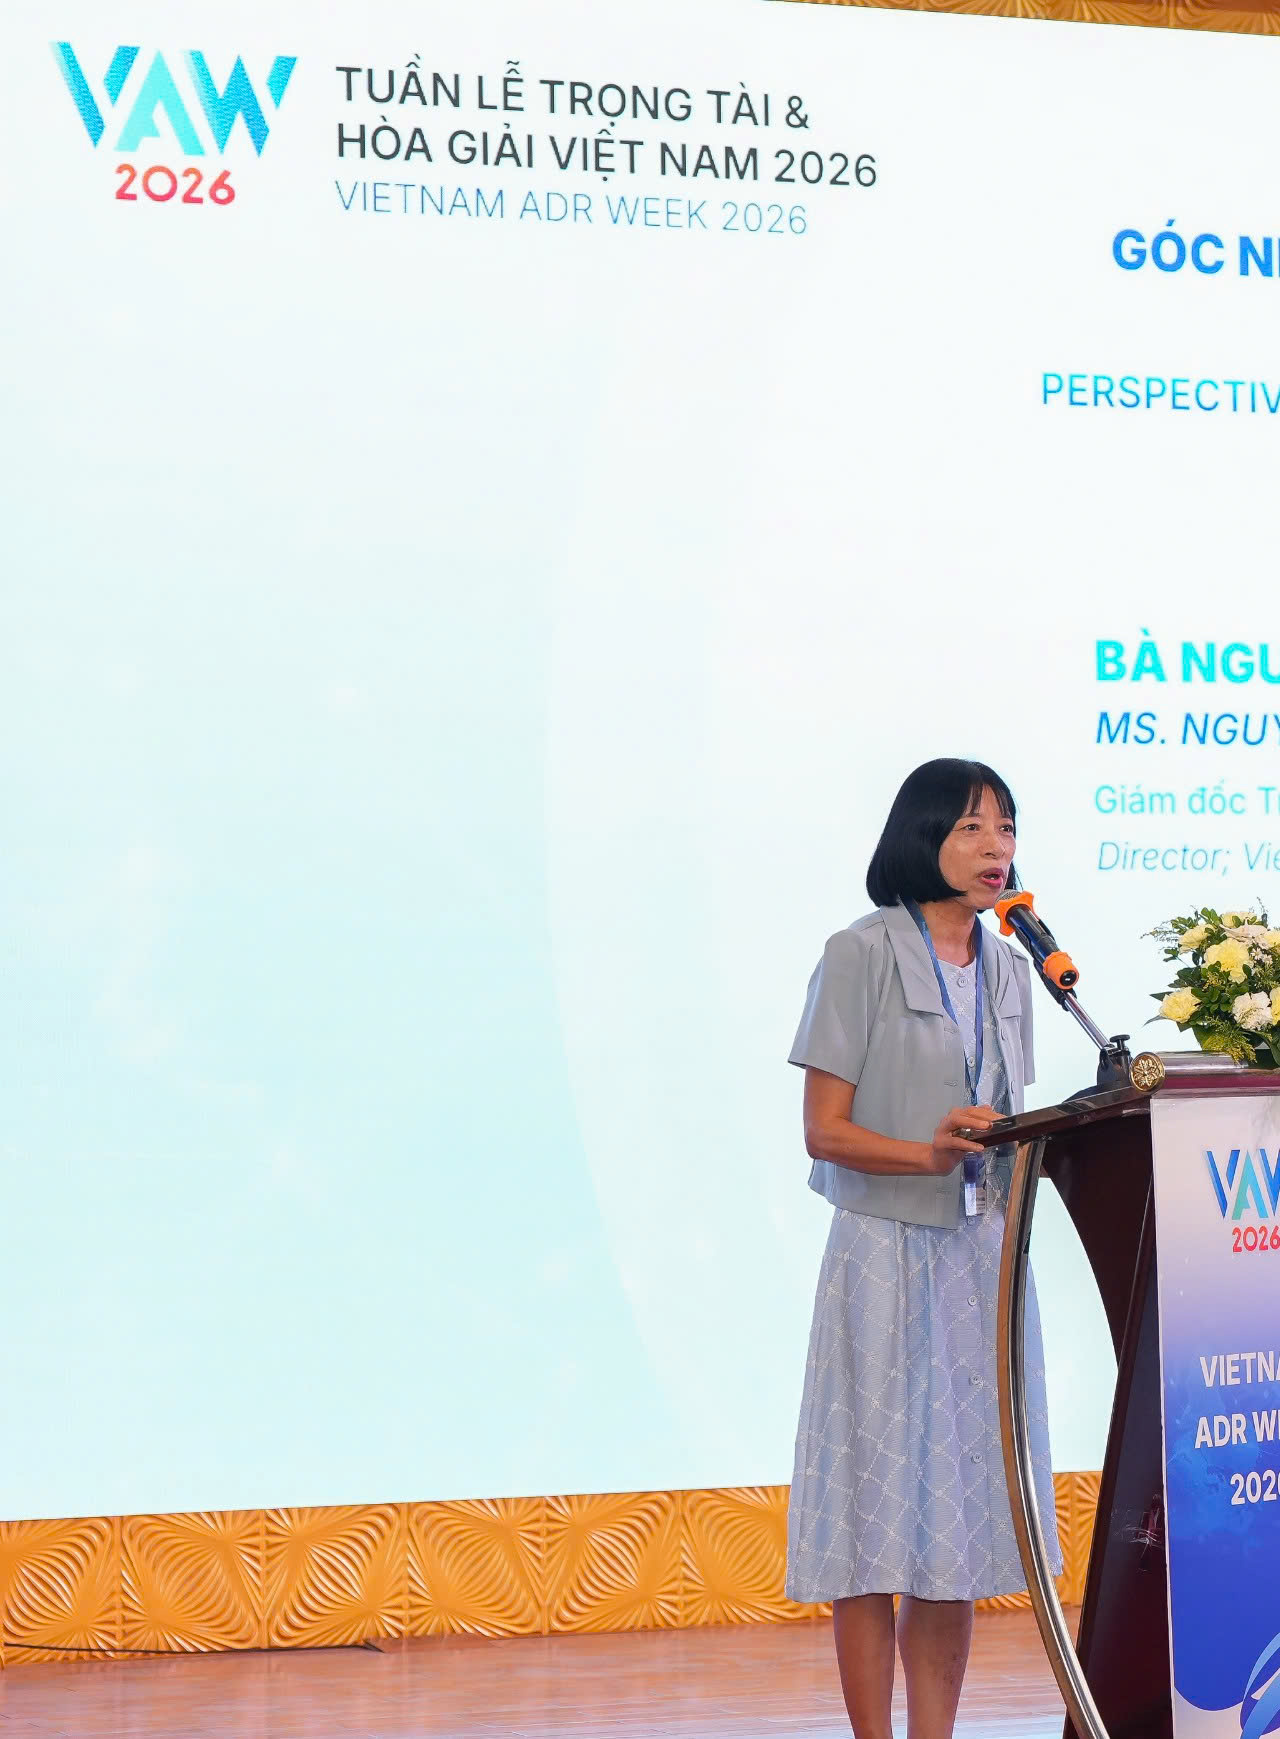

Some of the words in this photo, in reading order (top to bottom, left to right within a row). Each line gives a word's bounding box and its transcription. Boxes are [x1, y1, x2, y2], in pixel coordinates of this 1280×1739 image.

[49, 40, 298, 158] VAW
[336, 54, 460, 107] TUẦN
[478, 61, 524, 111] LỄ
[539, 80, 691, 127] TRỌNG
[707, 82, 769, 126] TÀI
[785, 96, 809, 128] &
[338, 123, 432, 162] HÒA
[448, 123, 533, 168] GIẢI
[549, 129, 644, 181] VIỆT
[661, 142, 758, 180] NAM
[775, 149, 876, 187] 2026
[116, 164, 235, 205] 2026
[335, 180, 504, 218] VIETNAM
[520, 190, 592, 224] ADR
[605, 195, 707, 229] WEEK
[722, 200, 808, 235] 2026
[1112, 219, 1224, 275] GÓC
[1096, 628, 1167, 683] BÀ
[1096, 712, 1166, 745] MS.
[1093, 784, 1176, 815] Giám
[1187, 779, 1246, 816] đốc
[1096, 840, 1232, 877] Director;
[1232, 1226, 1280, 1252] 2026
[1195, 1413, 1247, 1448] ADR
